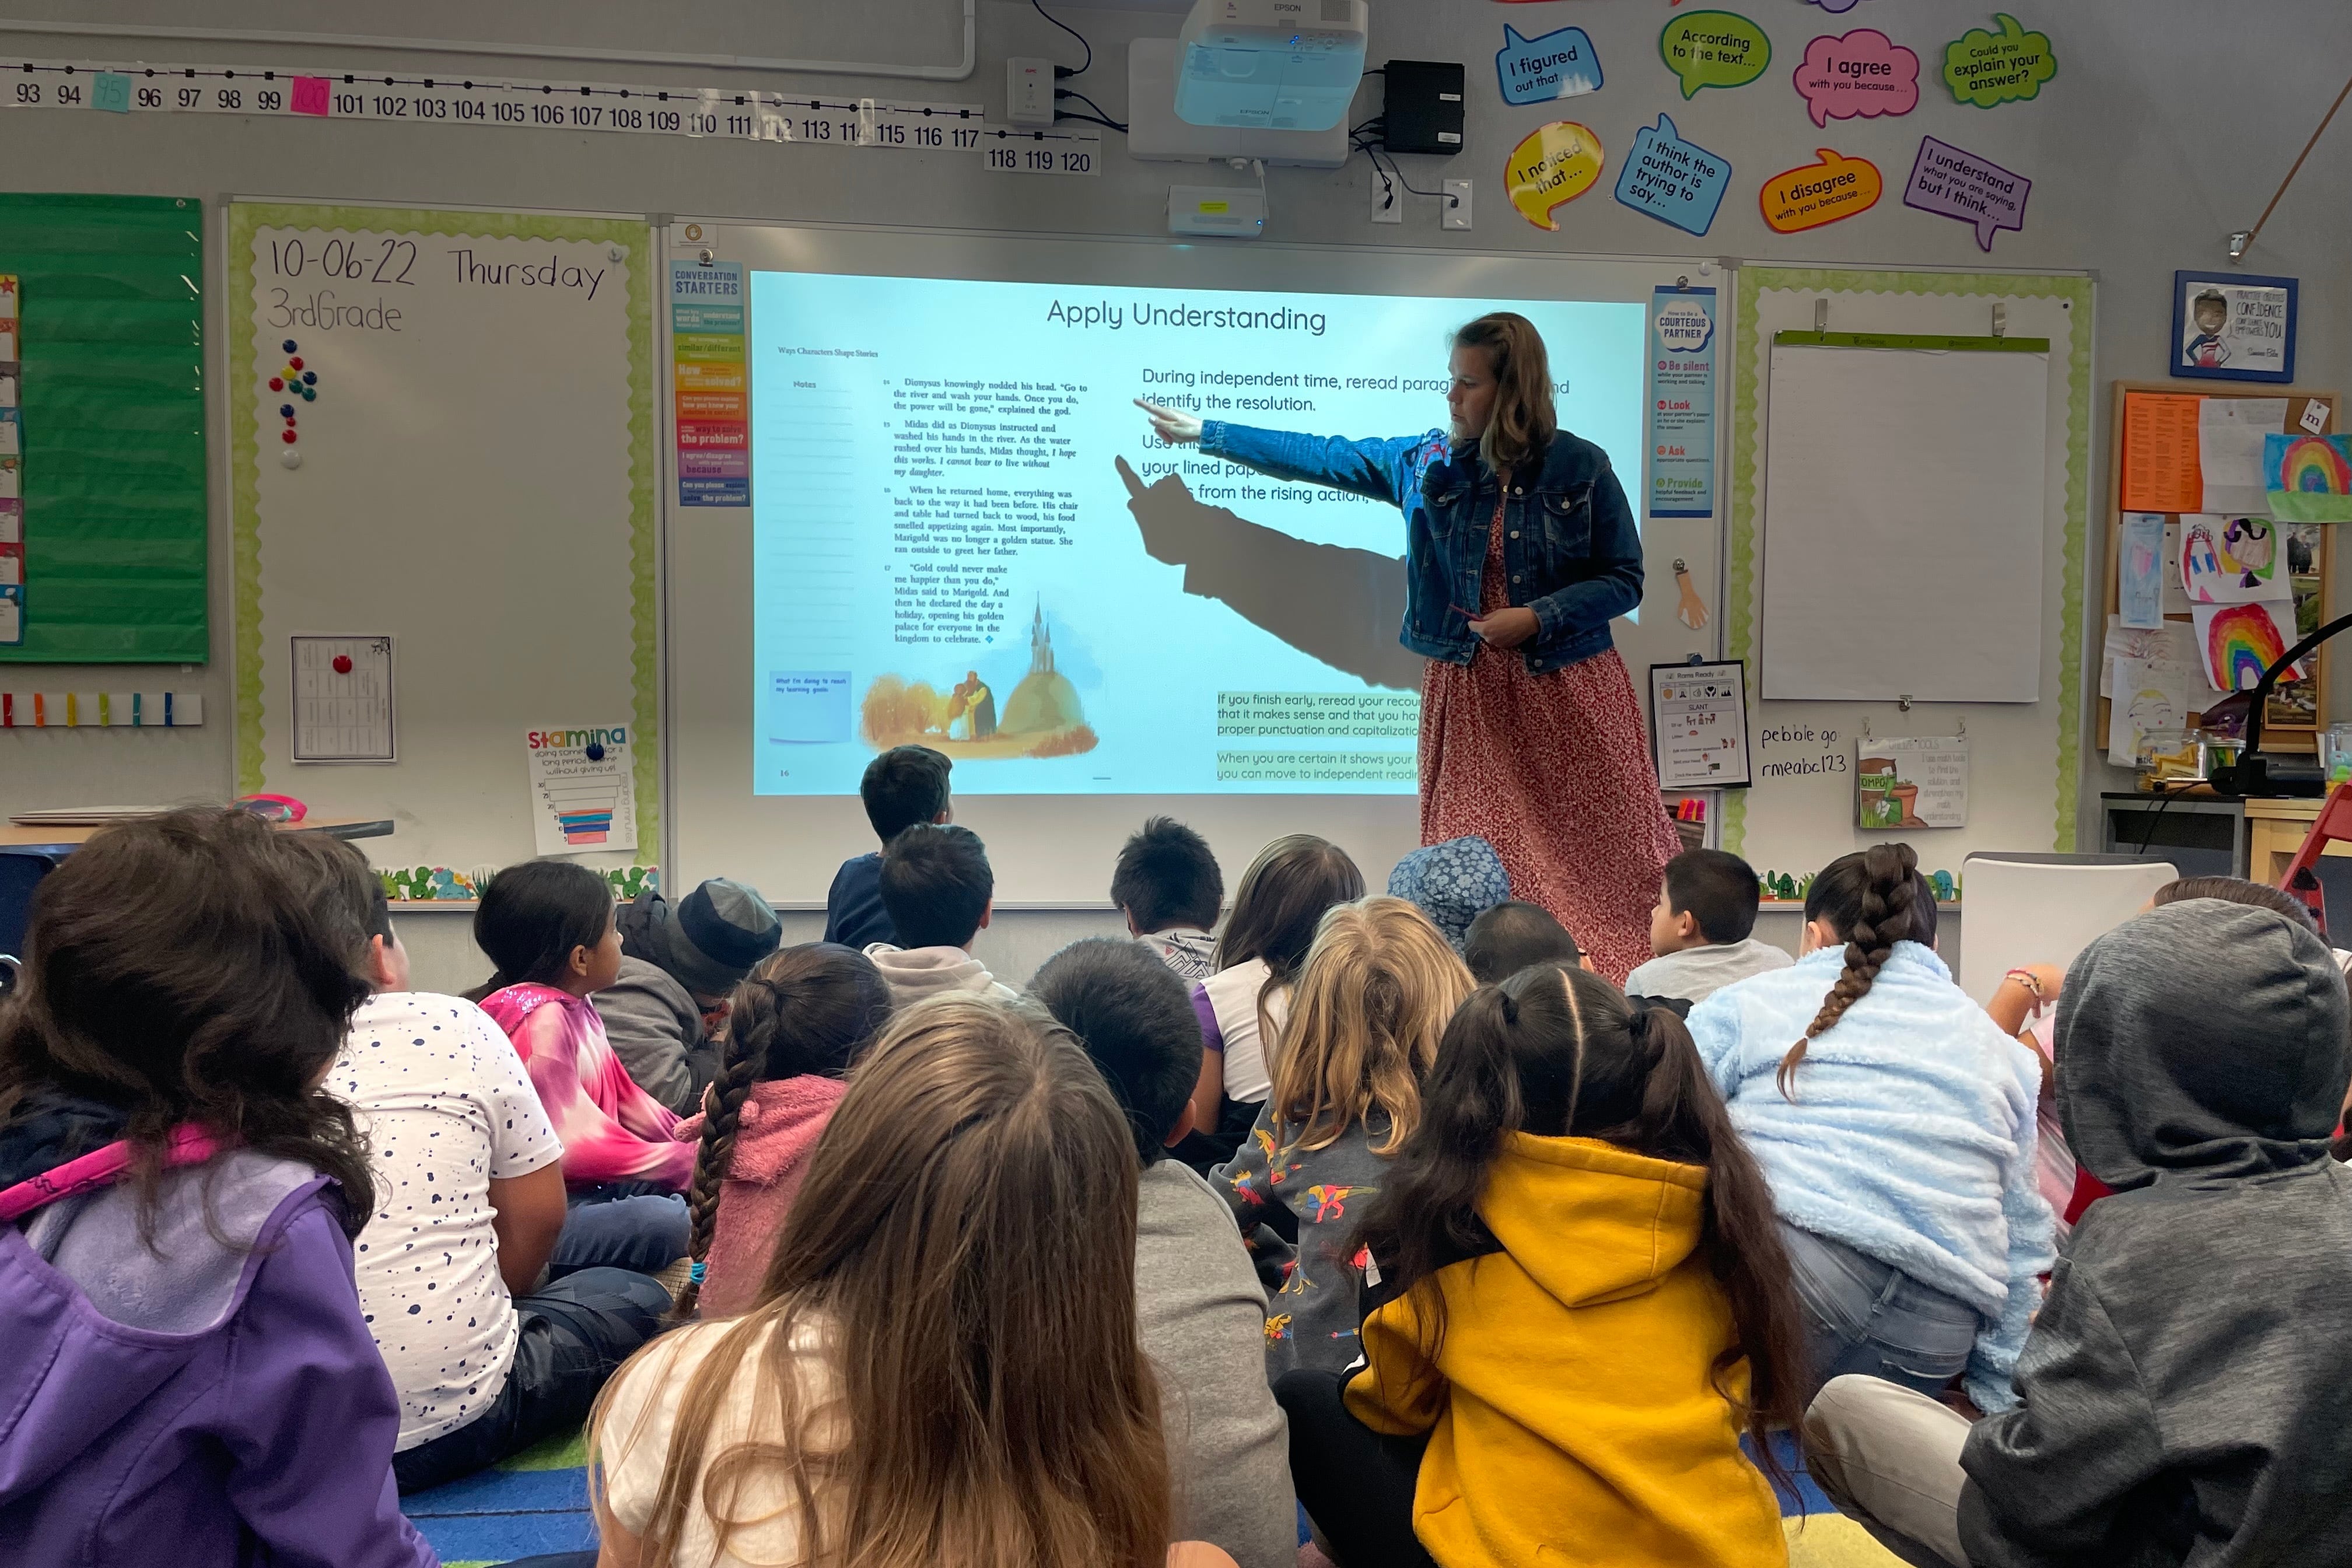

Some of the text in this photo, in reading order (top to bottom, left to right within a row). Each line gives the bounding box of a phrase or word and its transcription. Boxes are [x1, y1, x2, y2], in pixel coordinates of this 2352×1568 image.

[1274, 4, 1301, 12] EPSON
[1681, 29, 1751, 51] According
[1969, 44, 2019, 57] Could you
[1510, 45, 1578, 77] I figured
[1672, 44, 1755, 67] to the text...
[1954, 52, 2041, 77] explain your
[1827, 57, 1892, 79] I agree
[96, 78, 122, 104] 95
[1516, 79, 1533, 93] out
[1808, 79, 1831, 89] with
[1833, 81, 1852, 92] you
[1969, 69, 2029, 92] answer?
[16, 83, 41, 103] 93
[57, 85, 82, 104] 94
[138, 88, 162, 108] 96
[178, 88, 202, 107] 97
[218, 89, 242, 109] 98
[258, 90, 281, 110] 99
[333, 94, 363, 114] 101
[372, 96, 407, 117] 102
[412, 97, 446, 118] 103
[452, 99, 486, 120] 104
[491, 102, 525, 123] 105
[531, 104, 565, 124] 106
[570, 106, 603, 126] 107
[608, 108, 642, 129] 108
[647, 110, 680, 131] 109
[688, 113, 717, 133] 110
[726, 115, 751, 135] 111
[802, 119, 831, 140] 113
[877, 124, 905, 145] 115
[914, 126, 943, 146] 116
[951, 128, 979, 148] 117
[988, 148, 1090, 172] 118 119 120
[1517, 139, 1583, 183] I noticed
[1647, 137, 1716, 178] I think the
[1642, 155, 1702, 188] author is
[1927, 148, 2014, 194] I understand
[1535, 170, 1582, 195] that...
[1636, 168, 1693, 201] trying to
[1780, 172, 1856, 204] I disagree
[1919, 177, 1943, 195] but
[1945, 187, 1951, 199] I
[1923, 165, 2016, 211] what you are saying,
[1629, 185, 1666, 208] say...
[1774, 207, 1797, 220] with
[1798, 202, 1817, 216] you
[272, 239, 605, 301] 10-06-22 Thursday
[676, 270, 737, 281] CONVERSATION
[676, 281, 738, 295] STARTERS
[1046, 299, 1326, 337] Apply Understanding
[1660, 317, 1706, 327] COURTEOUS
[1664, 328, 1702, 338] PARTNER
[778, 346, 878, 359] Ways Characters Shape Stories
[1669, 360, 1710, 372] Be silent
[793, 380, 817, 388] Notes
[1143, 368, 1452, 395] During independent time, reread parag
[1142, 392, 1316, 412] identify the resolution.
[1668, 399, 1690, 410] Look
[904, 419, 929, 429] Midas
[931, 419, 946, 429] did
[960, 421, 996, 432] Dionysus
[999, 422, 1038, 432] instructed
[1041, 424, 1056, 433] and
[681, 433, 744, 446] the problem?
[1668, 445, 1686, 456] Ask
[1142, 459, 1220, 477] your lined
[1667, 477, 1703, 488] Provide
[1198, 483, 1237, 499] from
[1241, 485, 1266, 500] the
[1270, 486, 1312, 505] rising
[894, 633, 930, 645] kingdom
[944, 634, 981, 644] celebrate.
[1217, 693, 1384, 709] If you finish early, reread your
[1217, 708, 1399, 723] that it makes sense and that you
[1217, 724, 1350, 737] proper punctuation and
[1761, 724, 1838, 750] pebble go
[1216, 752, 1413, 766] When you are certain it shows your
[1762, 754, 1847, 777] rmeabc123
[1217, 768, 1383, 782] you can move to independent
